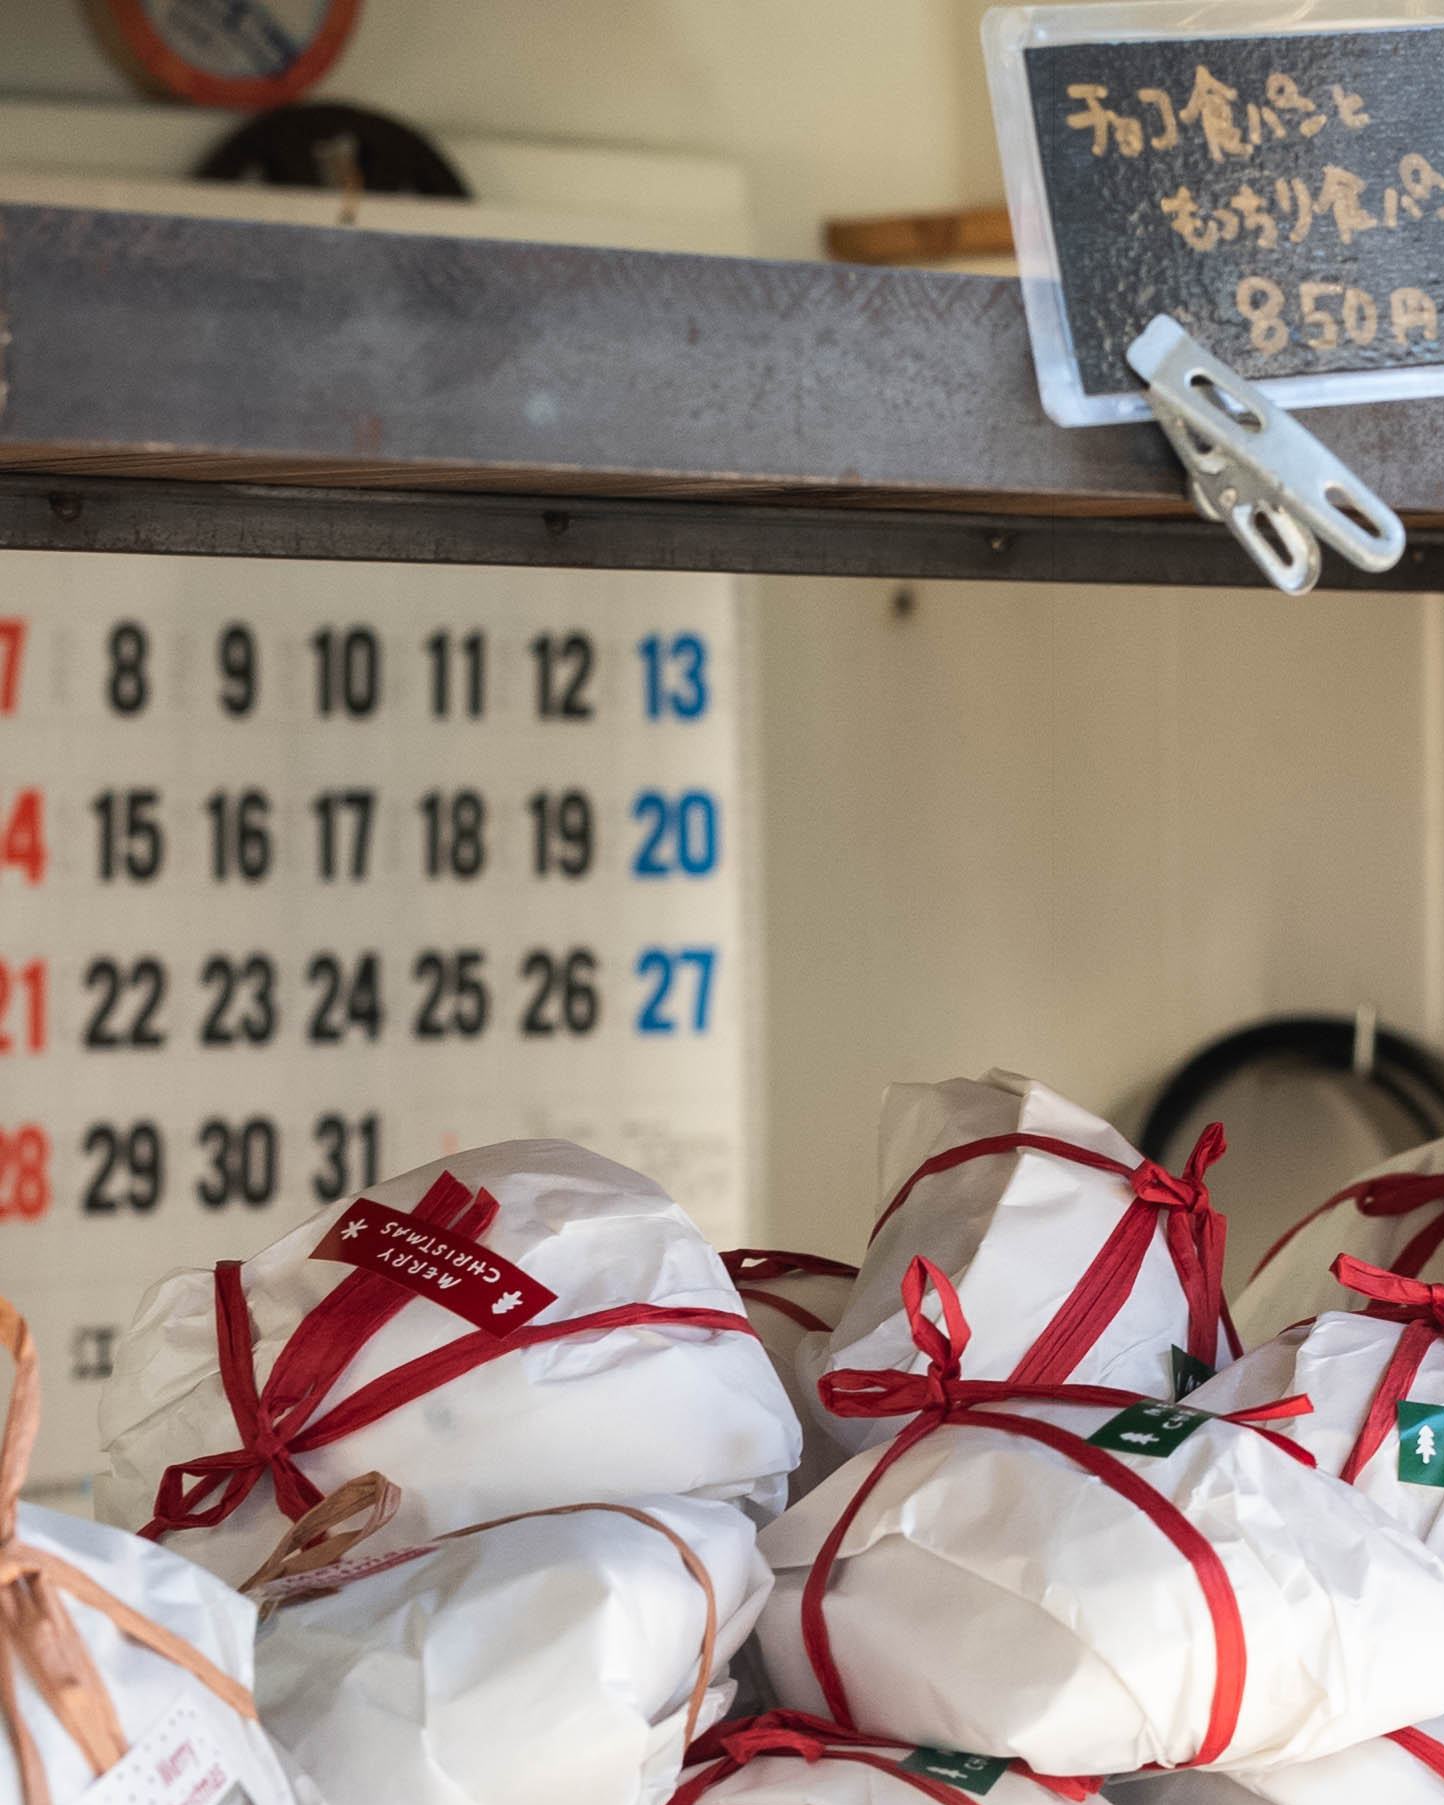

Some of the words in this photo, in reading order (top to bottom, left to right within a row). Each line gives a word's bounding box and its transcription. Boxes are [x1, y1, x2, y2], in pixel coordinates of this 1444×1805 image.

[1236, 276, 1438, 356] 850円
[106, 620, 151, 718] 8
[216, 621, 260, 720] 9
[309, 625, 384, 722] 10
[424, 629, 487, 720] 11
[529, 630, 597, 723] 12
[638, 632, 709, 721] 13
[0, 789, 47, 884] 4
[91, 787, 165, 884] 15
[205, 788, 275, 885] 16
[311, 788, 379, 882] 17
[419, 789, 488, 882] 18
[528, 789, 596, 880] 19
[632, 790, 719, 879] 20
[0, 960, 47, 1055] 1
[83, 956, 168, 1051] 22
[200, 953, 279, 1048] 23
[306, 951, 386, 1045] 24
[413, 949, 491, 1042] 25
[521, 948, 600, 1038] 26
[636, 948, 716, 1034] 27
[0, 1124, 50, 1222] 8
[82, 1121, 166, 1216] 29
[197, 1116, 281, 1211] 30
[312, 1112, 383, 1206] 31
[377, 1247, 463, 1290] MERRY
[379, 1220, 502, 1284] CHRISTMAS
